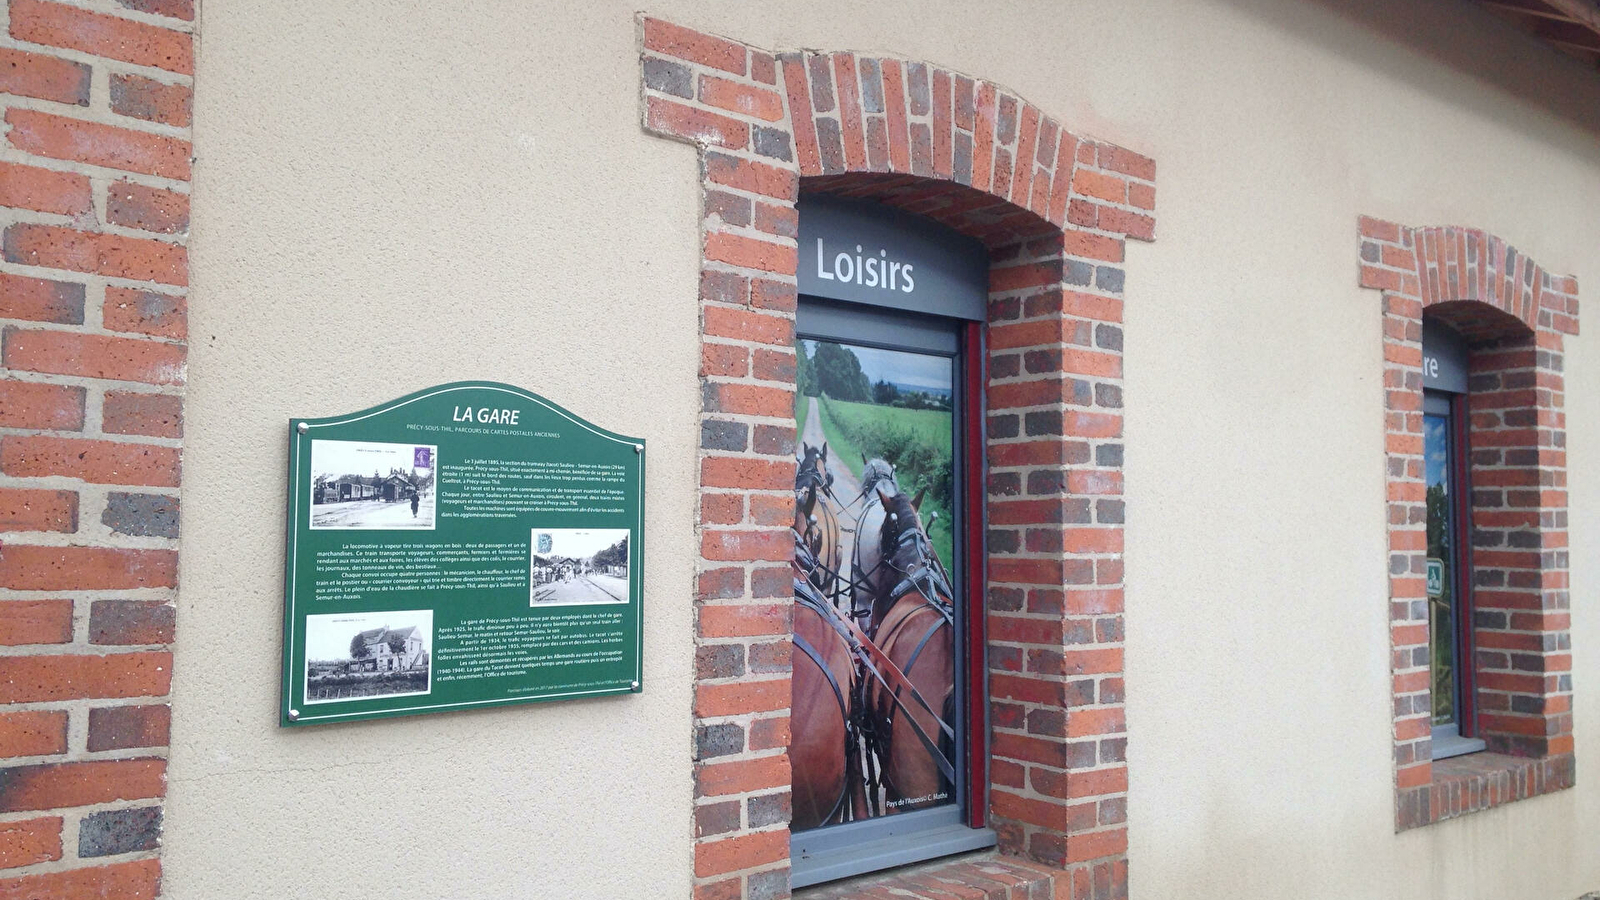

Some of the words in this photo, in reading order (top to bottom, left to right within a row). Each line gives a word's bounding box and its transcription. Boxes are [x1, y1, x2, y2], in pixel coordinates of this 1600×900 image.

[817, 238, 915, 293] Loisirs
[1422, 356, 1438, 378] re
[453, 406, 473, 422] LA
[477, 408, 521, 425] GARE
